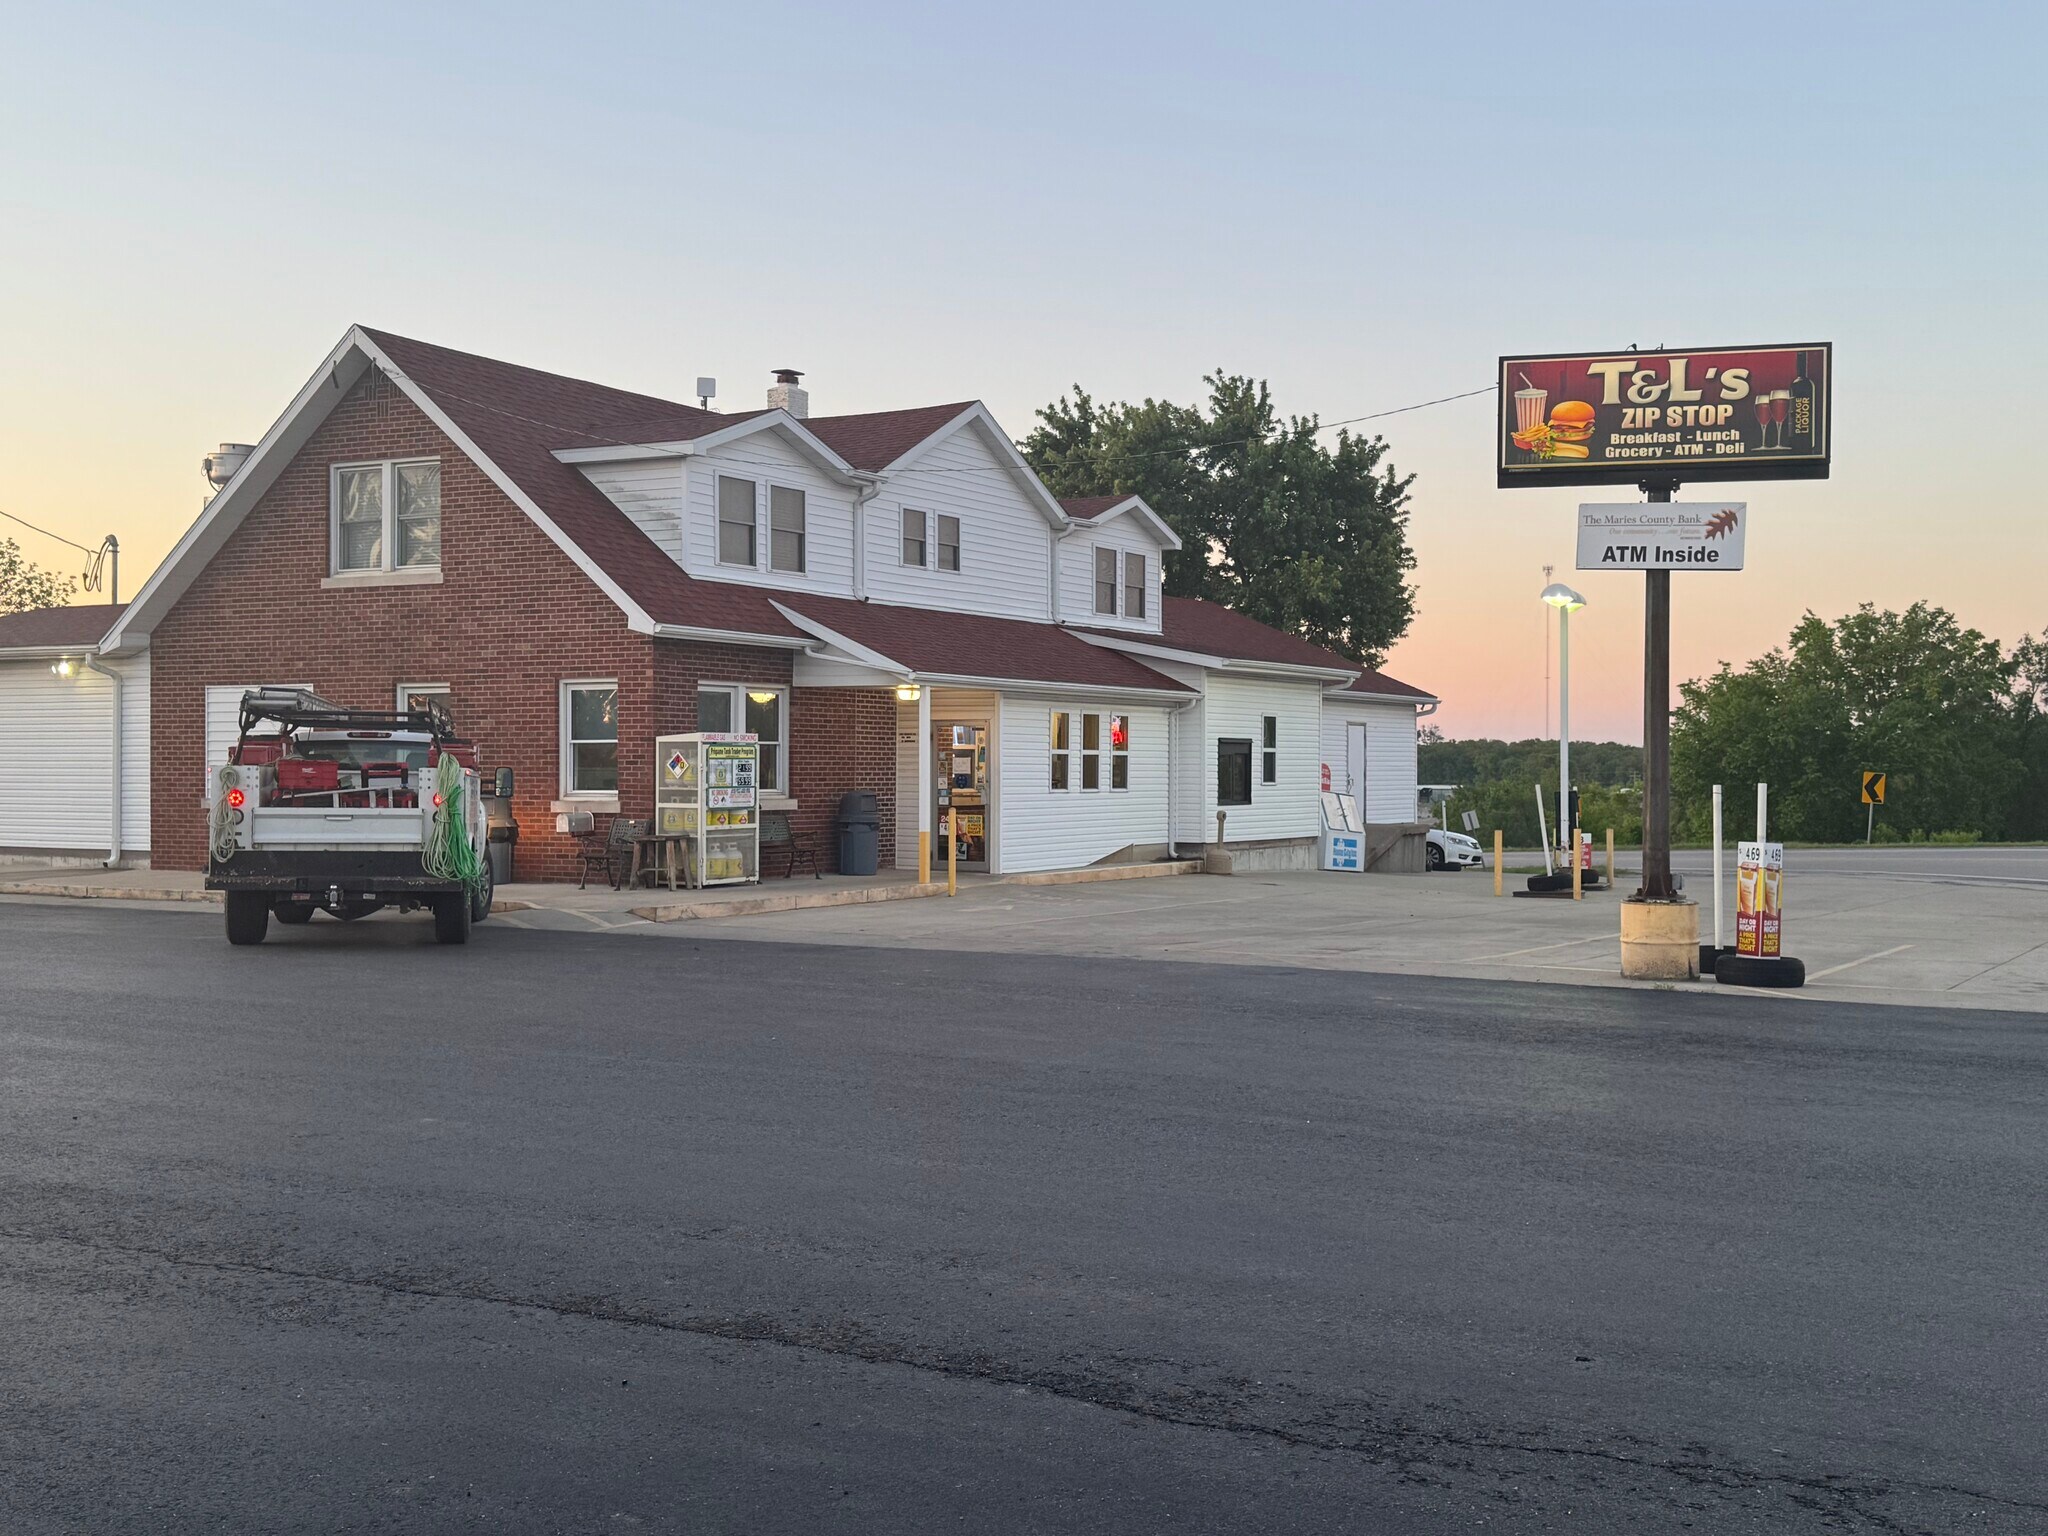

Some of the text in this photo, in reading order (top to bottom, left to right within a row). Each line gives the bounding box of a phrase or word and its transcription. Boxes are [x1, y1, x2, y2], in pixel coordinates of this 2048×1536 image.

[1587, 358, 1750, 405] T&L's
[1621, 404, 1734, 430] ZIP STOP
[1802, 397, 1810, 433] LIQUOR
[1610, 432, 1681, 444] Breakfast
[1696, 429, 1740, 442] Lunch
[1605, 445, 1662, 459] Grocery
[1674, 444, 1703, 456] ATM
[1715, 442, 1745, 455] Deli
[1583, 514, 1702, 527] The Maries County Bank
[1602, 546, 1719, 562] ATM Inside
